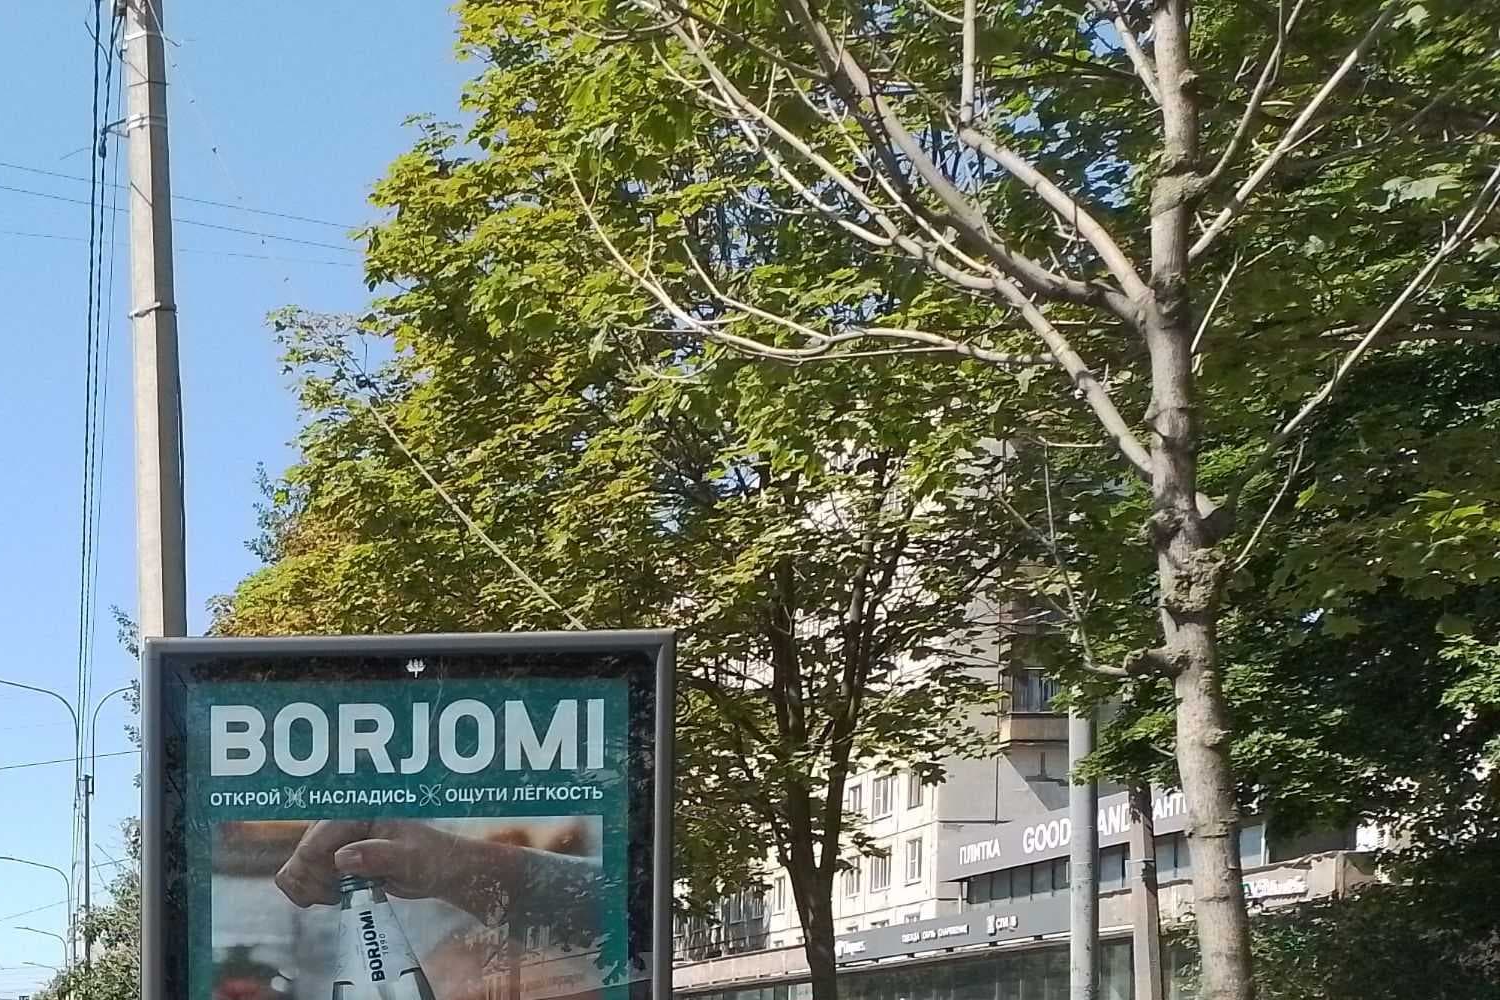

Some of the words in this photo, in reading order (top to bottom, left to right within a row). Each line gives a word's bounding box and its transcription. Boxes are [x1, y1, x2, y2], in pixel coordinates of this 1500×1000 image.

[210, 698, 605, 776] BORJOMI
[210, 788, 281, 807] ОТКРОЙ
[309, 788, 417, 806] НАСЛАДИСЬ
[445, 787, 507, 804] ОЩУТИ
[959, 838, 1001, 866] ПЛИТКА
[359, 910, 385, 982] BORJOMI
